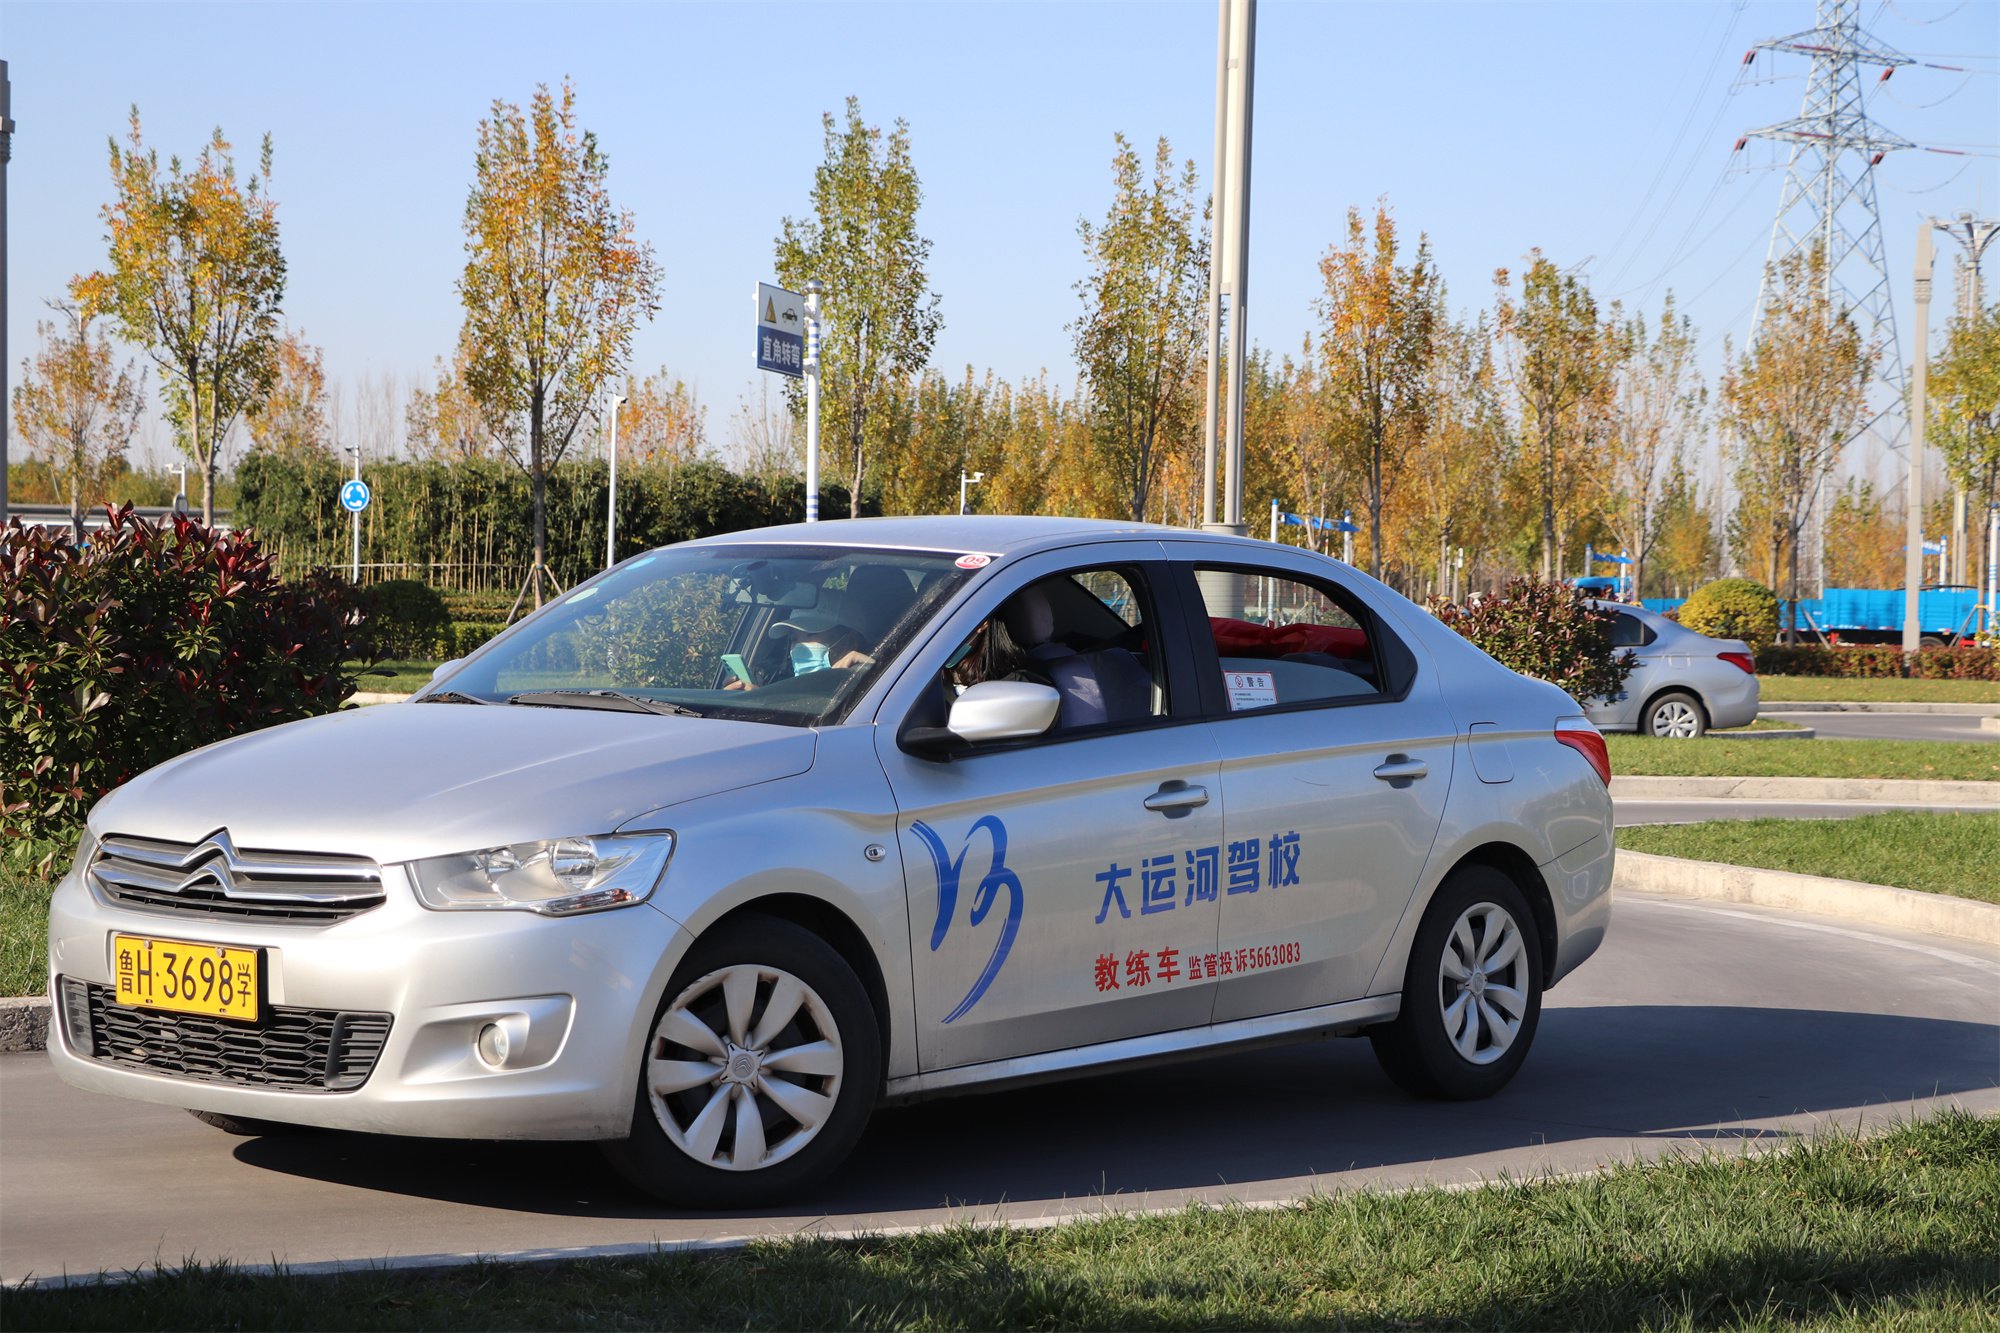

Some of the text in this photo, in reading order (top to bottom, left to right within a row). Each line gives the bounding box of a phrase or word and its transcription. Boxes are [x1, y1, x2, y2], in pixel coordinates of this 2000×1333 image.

[762, 336, 801, 368] 直角转弯
[963, 556, 986, 565] 09
[1246, 676, 1265, 688] 警告
[1095, 830, 1301, 924] 大运河驾校
[1094, 941, 1301, 992] 教练车 监管投诉5663083
